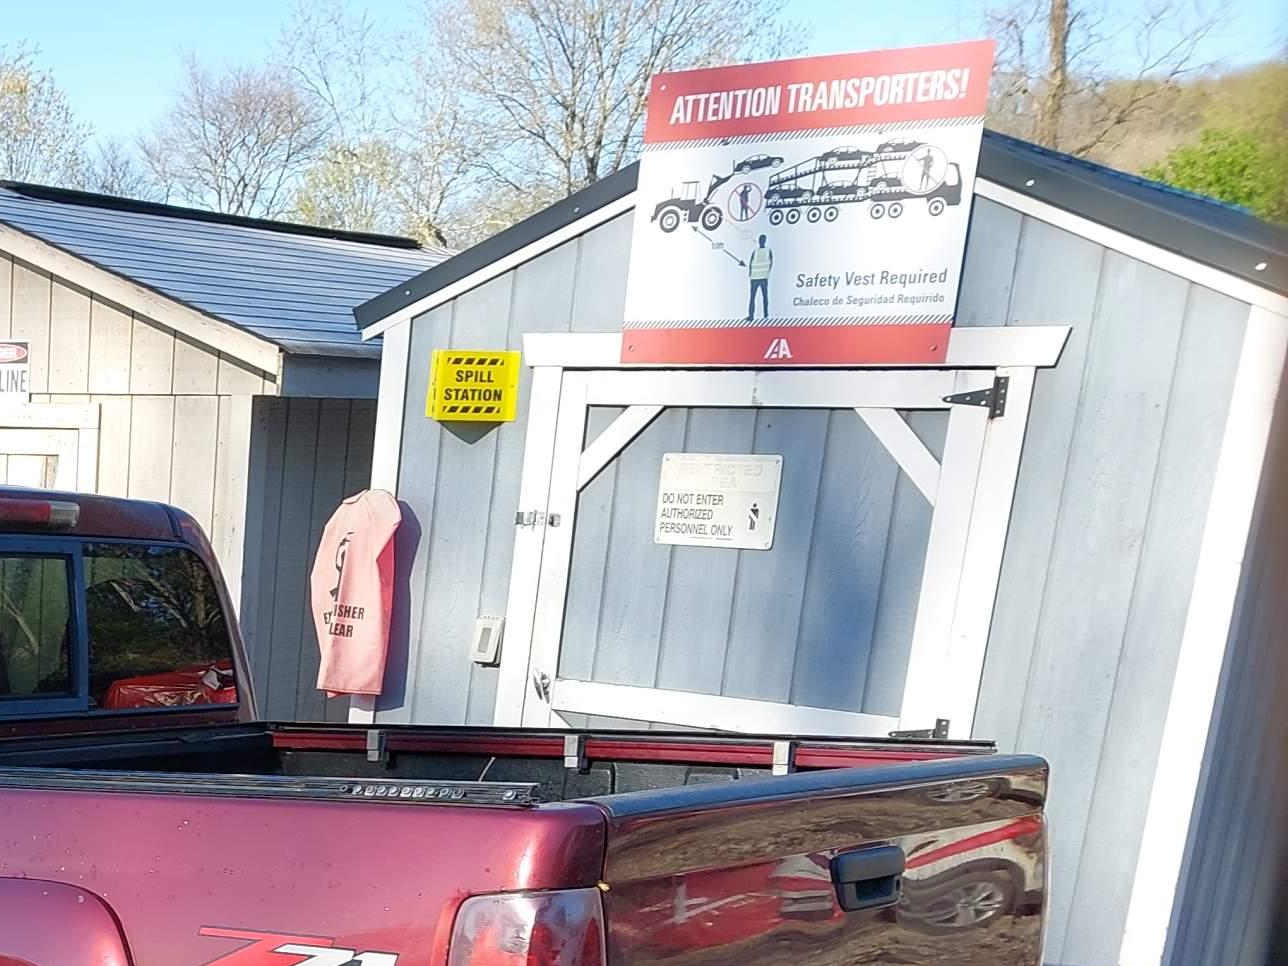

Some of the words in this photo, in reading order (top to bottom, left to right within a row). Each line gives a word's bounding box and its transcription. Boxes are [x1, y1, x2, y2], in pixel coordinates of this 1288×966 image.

[669, 85, 781, 125] ATTENTION
[786, 68, 970, 113] TRANSPORTERS!
[796, 272, 840, 289] Safety
[845, 271, 875, 286] Vest
[880, 268, 948, 288] Required
[793, 296, 829, 306] Chaleco
[832, 296, 843, 305] de
[847, 294, 895, 307] Seguridad
[897, 293, 945, 304] Requirido
[455, 370, 494, 383] SPILL
[444, 388, 502, 401] STATION
[663, 492, 674, 504] DO
[677, 493, 694, 505] NOT
[696, 494, 724, 506] ENTER
[661, 508, 713, 520] AUTHORIZED
[659, 522, 708, 535] PERSONNEL
[711, 524, 734, 537] ONLY
